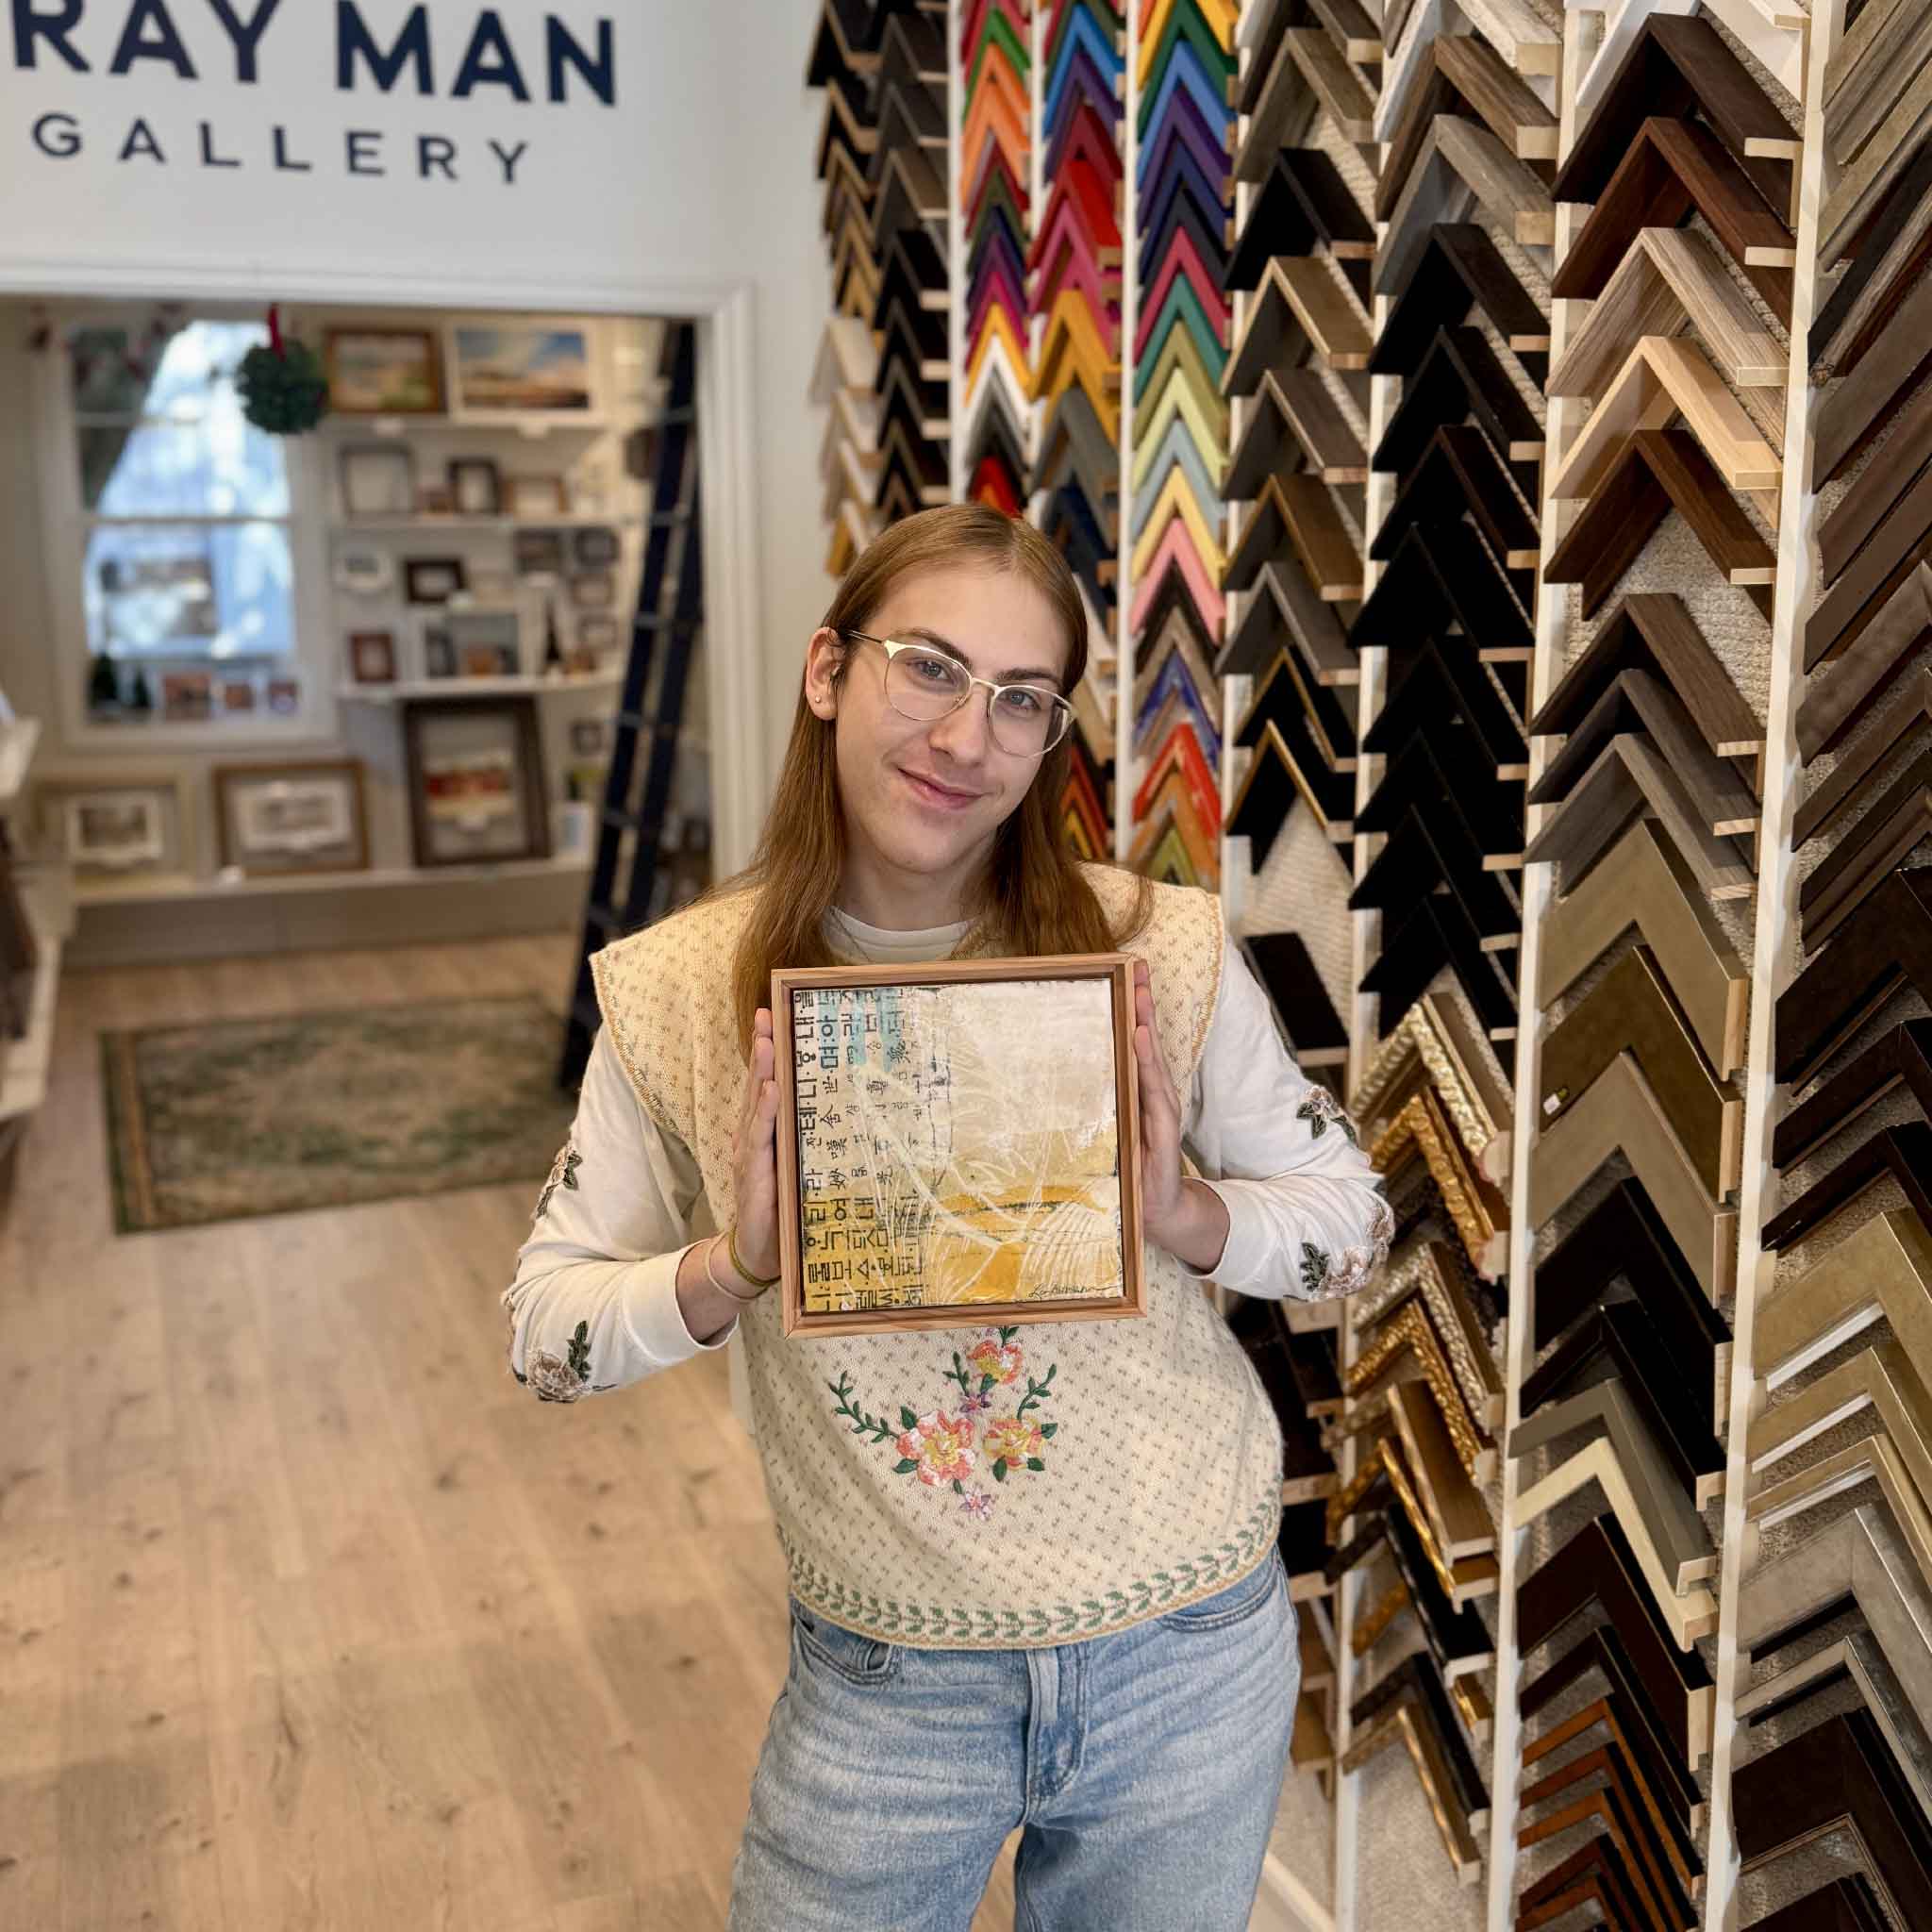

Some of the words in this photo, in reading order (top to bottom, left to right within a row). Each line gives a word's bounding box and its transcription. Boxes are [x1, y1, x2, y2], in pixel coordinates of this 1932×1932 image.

[10, 0, 280, 84] RAY
[336, 0, 617, 107] MAN
[31, 112, 528, 184] GALLERY
